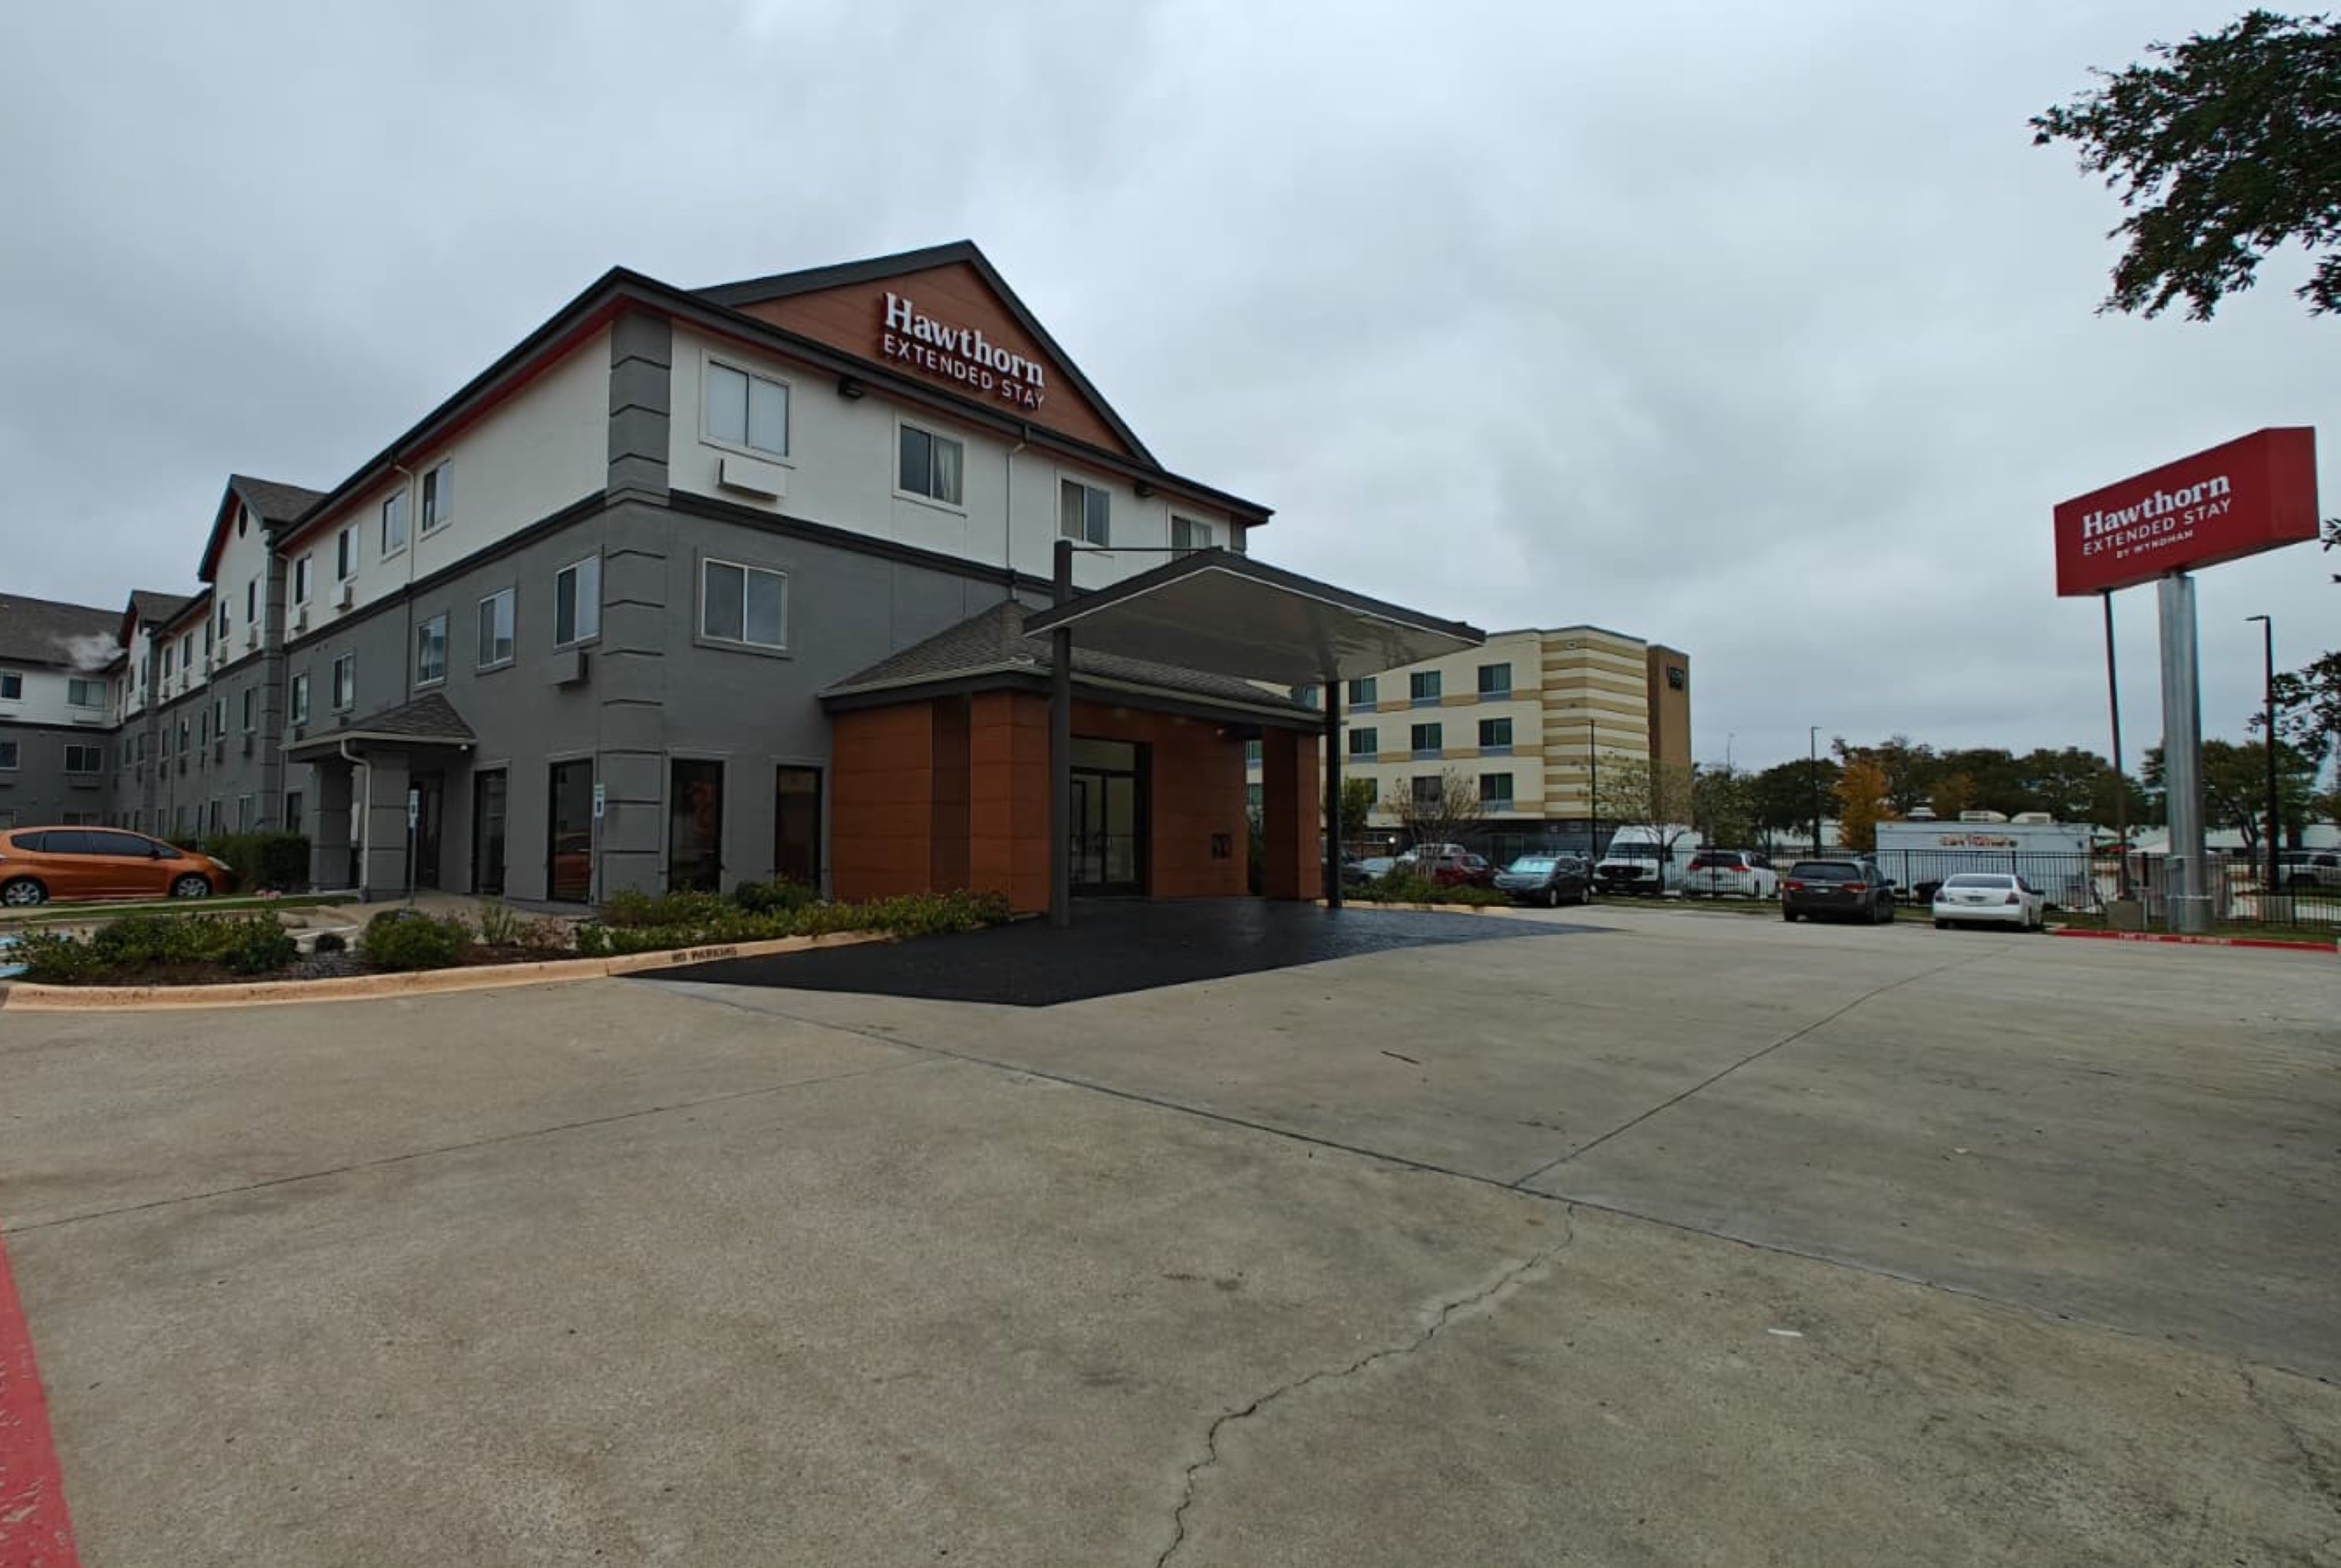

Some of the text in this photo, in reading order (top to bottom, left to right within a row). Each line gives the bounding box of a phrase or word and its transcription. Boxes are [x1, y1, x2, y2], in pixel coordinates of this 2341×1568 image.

[883, 333, 1044, 411] EXTENDED STAY
[885, 292, 1044, 388] Hawthorn
[2083, 475, 2230, 539] Hawthorn
[2083, 498, 2231, 556] EXTENDED STAY
[2134, 529, 2193, 554] WYNDHAM
